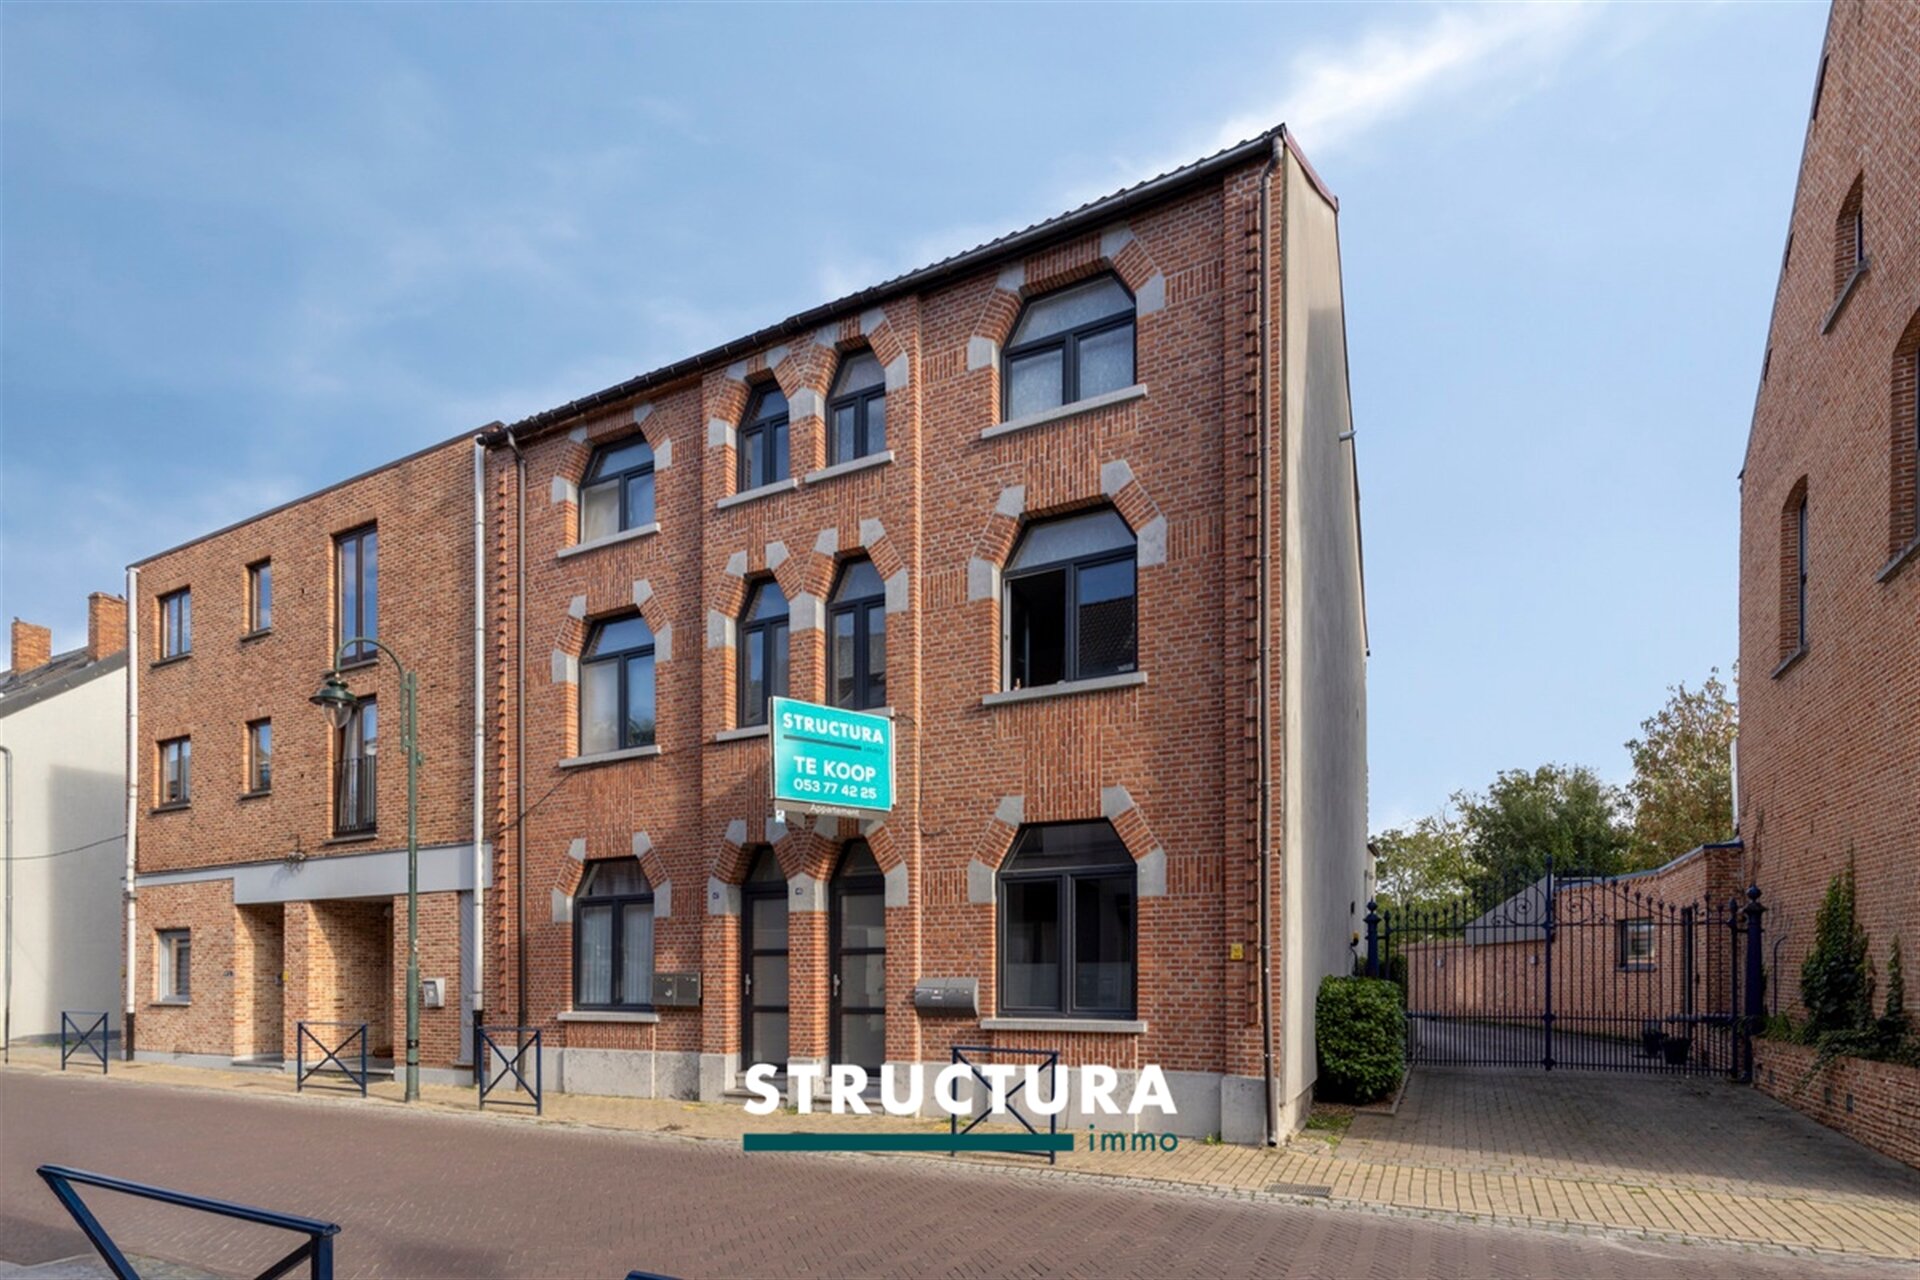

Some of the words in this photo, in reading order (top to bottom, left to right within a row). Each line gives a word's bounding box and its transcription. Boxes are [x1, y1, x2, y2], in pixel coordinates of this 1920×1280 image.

[783, 713, 884, 744] STRUCTURA
[793, 756, 817, 775] TE
[824, 760, 876, 782] KOOP
[793, 778, 820, 792] 053
[823, 782, 838, 794] 77
[841, 784, 858, 798] 42
[860, 787, 877, 800] 25
